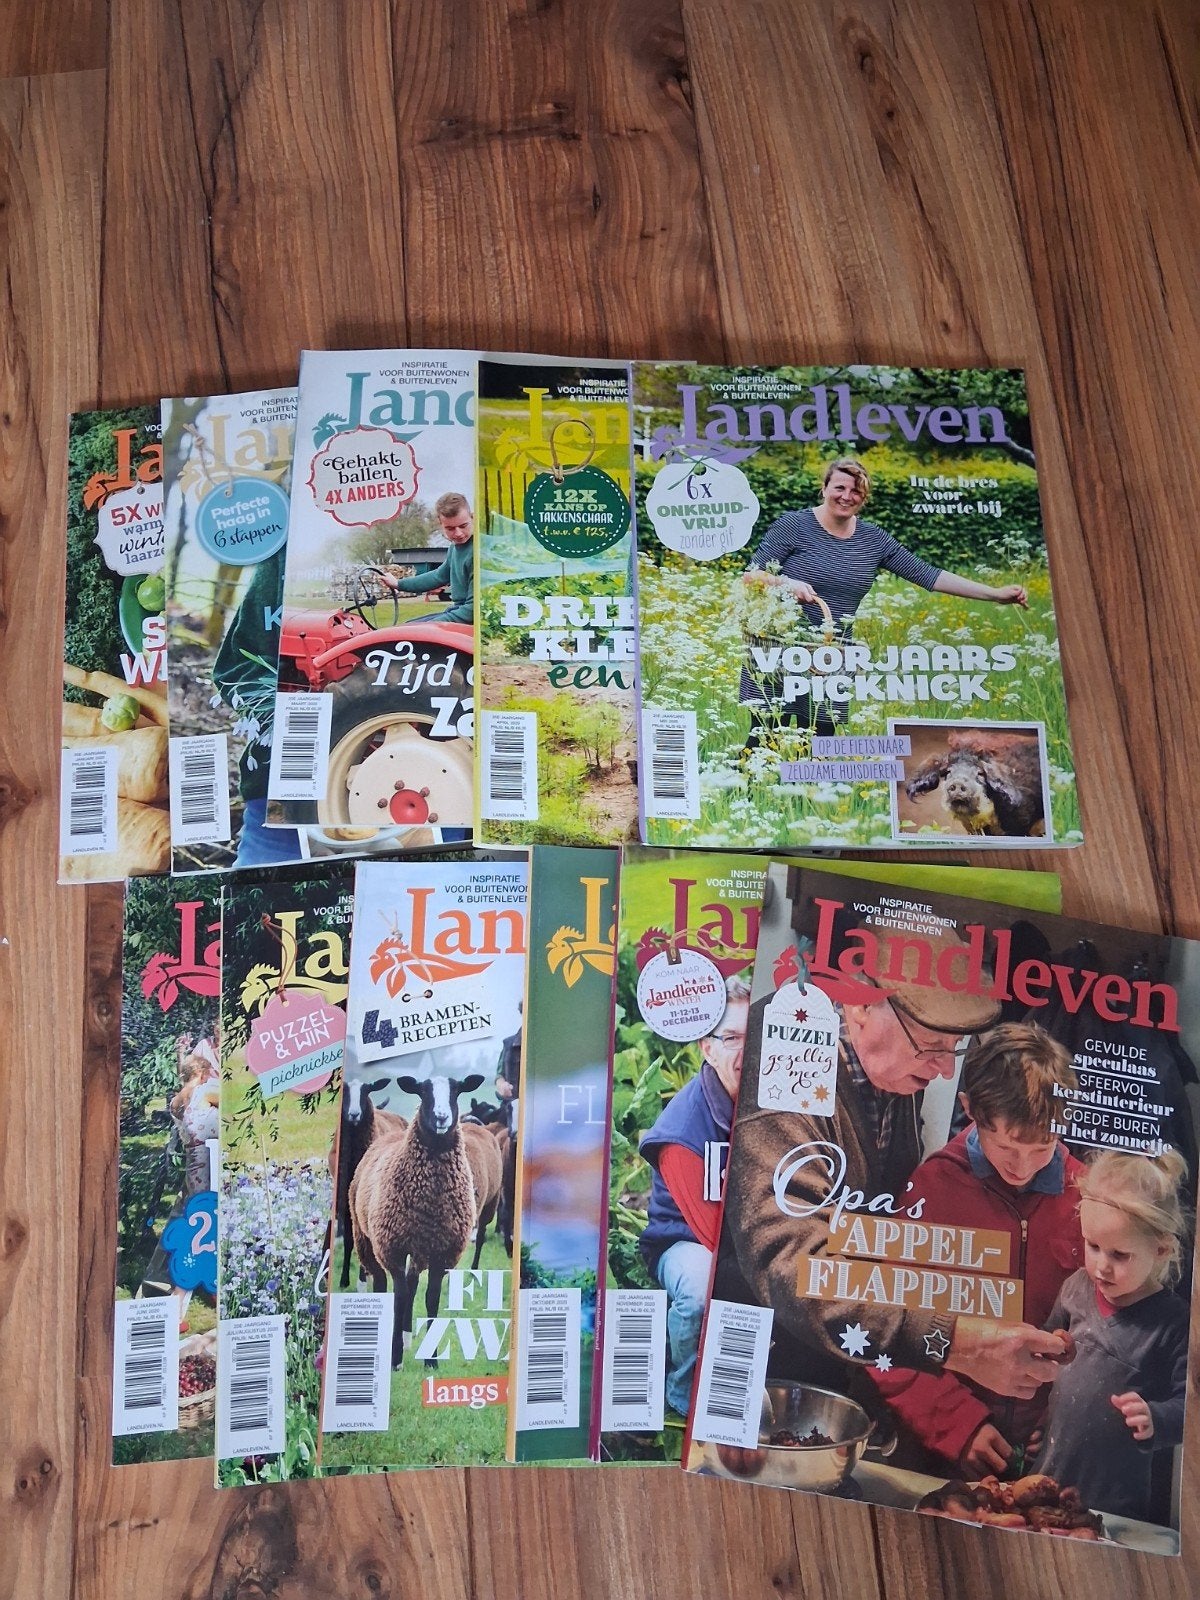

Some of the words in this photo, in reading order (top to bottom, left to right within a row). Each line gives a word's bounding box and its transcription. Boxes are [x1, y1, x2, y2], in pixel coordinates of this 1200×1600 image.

[379, 369, 404, 377] VOOR
[406, 369, 470, 377] BUITENWONEN
[390, 377, 396, 385] &
[399, 377, 457, 385] BUITENLEVEN
[733, 375, 779, 384] INSPIRATIE
[557, 386, 583, 394] VOOR
[579, 378, 626, 387] INSPIRATIE
[711, 383, 735, 392] VOOR
[737, 383, 802, 392] BUITENWONEN
[569, 394, 576, 402] &
[732, 392, 790, 400] BUITENLEVEN
[240, 408, 265, 417] VOOR
[676, 384, 1012, 444] Landleven
[323, 451, 402, 471] Gehakt
[339, 468, 397, 485] ballen
[910, 474, 930, 488] In
[933, 474, 955, 488] de
[957, 474, 998, 489] bres
[325, 489, 343, 505] 4X
[347, 481, 405, 503] ANDERS
[553, 489, 598, 503] 12X
[923, 489, 963, 501] voor
[111, 503, 142, 527] 5X
[211, 496, 270, 519] Perfecte
[544, 503, 584, 512] KANS
[587, 503, 608, 512] OP
[656, 502, 750, 518] ONKRUID-
[912, 501, 975, 515] zwarte
[977, 500, 1002, 518] bij
[216, 512, 255, 530] haag
[256, 507, 271, 519] in
[539, 512, 613, 523] TAKKENSCHAAR
[681, 516, 728, 530] VRIJ
[230, 524, 282, 545] stappen
[573, 526, 581, 535] €
[680, 529, 717, 549] zonder
[719, 526, 735, 553] gif
[751, 644, 1017, 674] VOORJAARS
[365, 641, 458, 695] Tijd
[547, 664, 630, 690] een
[783, 674, 990, 701] PICKNICK
[818, 739, 831, 755] OP
[834, 739, 847, 755] DE
[850, 739, 875, 754] FIETS
[878, 738, 906, 754] NAAR
[788, 764, 837, 780] ZELDZAME
[840, 764, 898, 780] HUISDIEREN
[470, 875, 521, 883] INSPIRATIE
[706, 878, 733, 887] VOOR
[444, 885, 472, 893] VOOR
[719, 889, 726, 898] &
[457, 895, 464, 903] &
[879, 897, 933, 914] INSPIRATIE
[313, 905, 342, 916] VOOR
[853, 902, 881, 915] VOOR
[884, 908, 957, 928] BUITENWONEN
[327, 916, 335, 925] &
[865, 915, 872, 924] &
[874, 917, 942, 936] BUITENLEVEN
[655, 969, 675, 978] KOM
[677, 966, 700, 975] NAAR
[813, 897, 1182, 1033] Landleven
[648, 983, 716, 1003] Landleven
[667, 995, 702, 1007] WINTER
[400, 1002, 480, 1029] BRAMEN-
[662, 1013, 711, 1027] DECEMBER
[670, 1007, 700, 1018] 11-12-13
[260, 1009, 335, 1049] PUZZEL
[362, 1009, 398, 1049] 4
[402, 1014, 492, 1045] RECEPTEN
[767, 1024, 836, 1047] PUZZEL
[275, 1043, 291, 1059] &
[294, 1024, 331, 1052] WIN
[1085, 1039, 1147, 1060] GEVULDE
[762, 1048, 832, 1076] gezellig
[1074, 1053, 1157, 1077] speculaas
[1080, 1074, 1148, 1097] SFEERVOL
[1053, 1083, 1174, 1117] kerstinterieur
[1063, 1108, 1110, 1127] GOEDE
[1114, 1117, 1160, 1136] BUREN
[1050, 1119, 1067, 1135] in
[1071, 1123, 1098, 1140] het
[1100, 1131, 1173, 1157] zonnetje
[414, 1317, 511, 1360] ZW
[426, 1375, 499, 1409] langs
[528, 1419, 566, 1427] LANDLEVEN.NL
[706, 1433, 743, 1443] LANDLEVEN.NL
[233, 1445, 271, 1454] LANDLEVEN.NL
